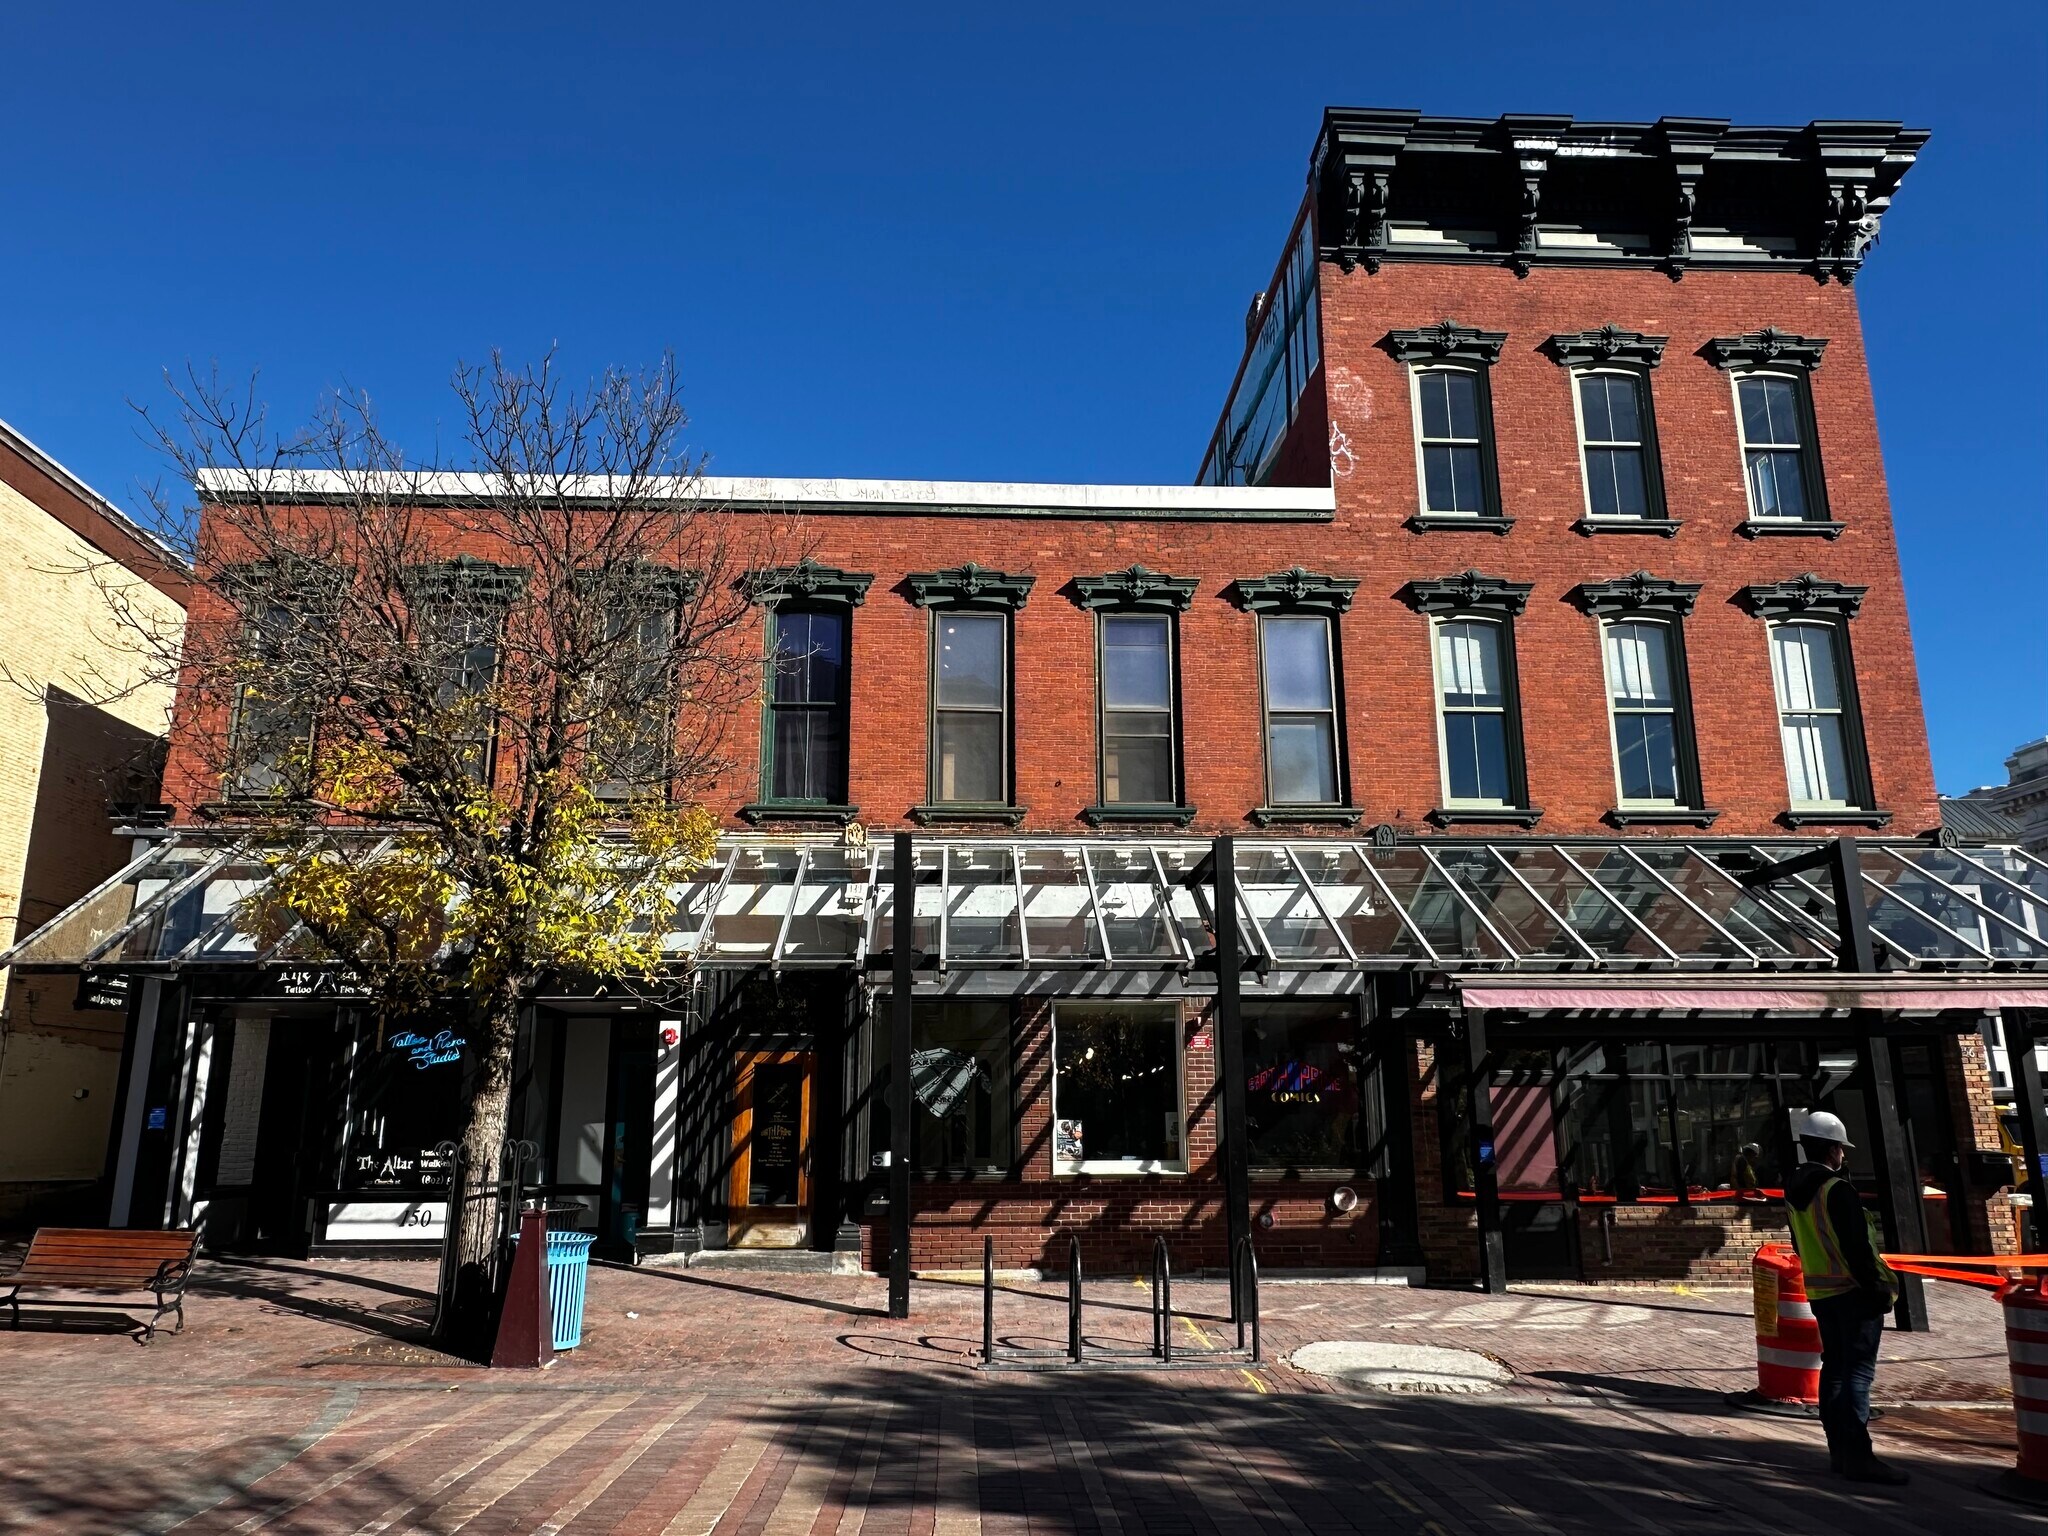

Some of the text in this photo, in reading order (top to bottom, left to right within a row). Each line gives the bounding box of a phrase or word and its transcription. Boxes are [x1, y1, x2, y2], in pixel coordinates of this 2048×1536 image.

[284, 985, 312, 994] Tattoo
[388, 1031, 427, 1048] Tattoo
[411, 1039, 433, 1054] and
[407, 1050, 460, 1069] Studio
[356, 1155, 413, 1177] The Altar
[399, 1210, 431, 1228] 150
